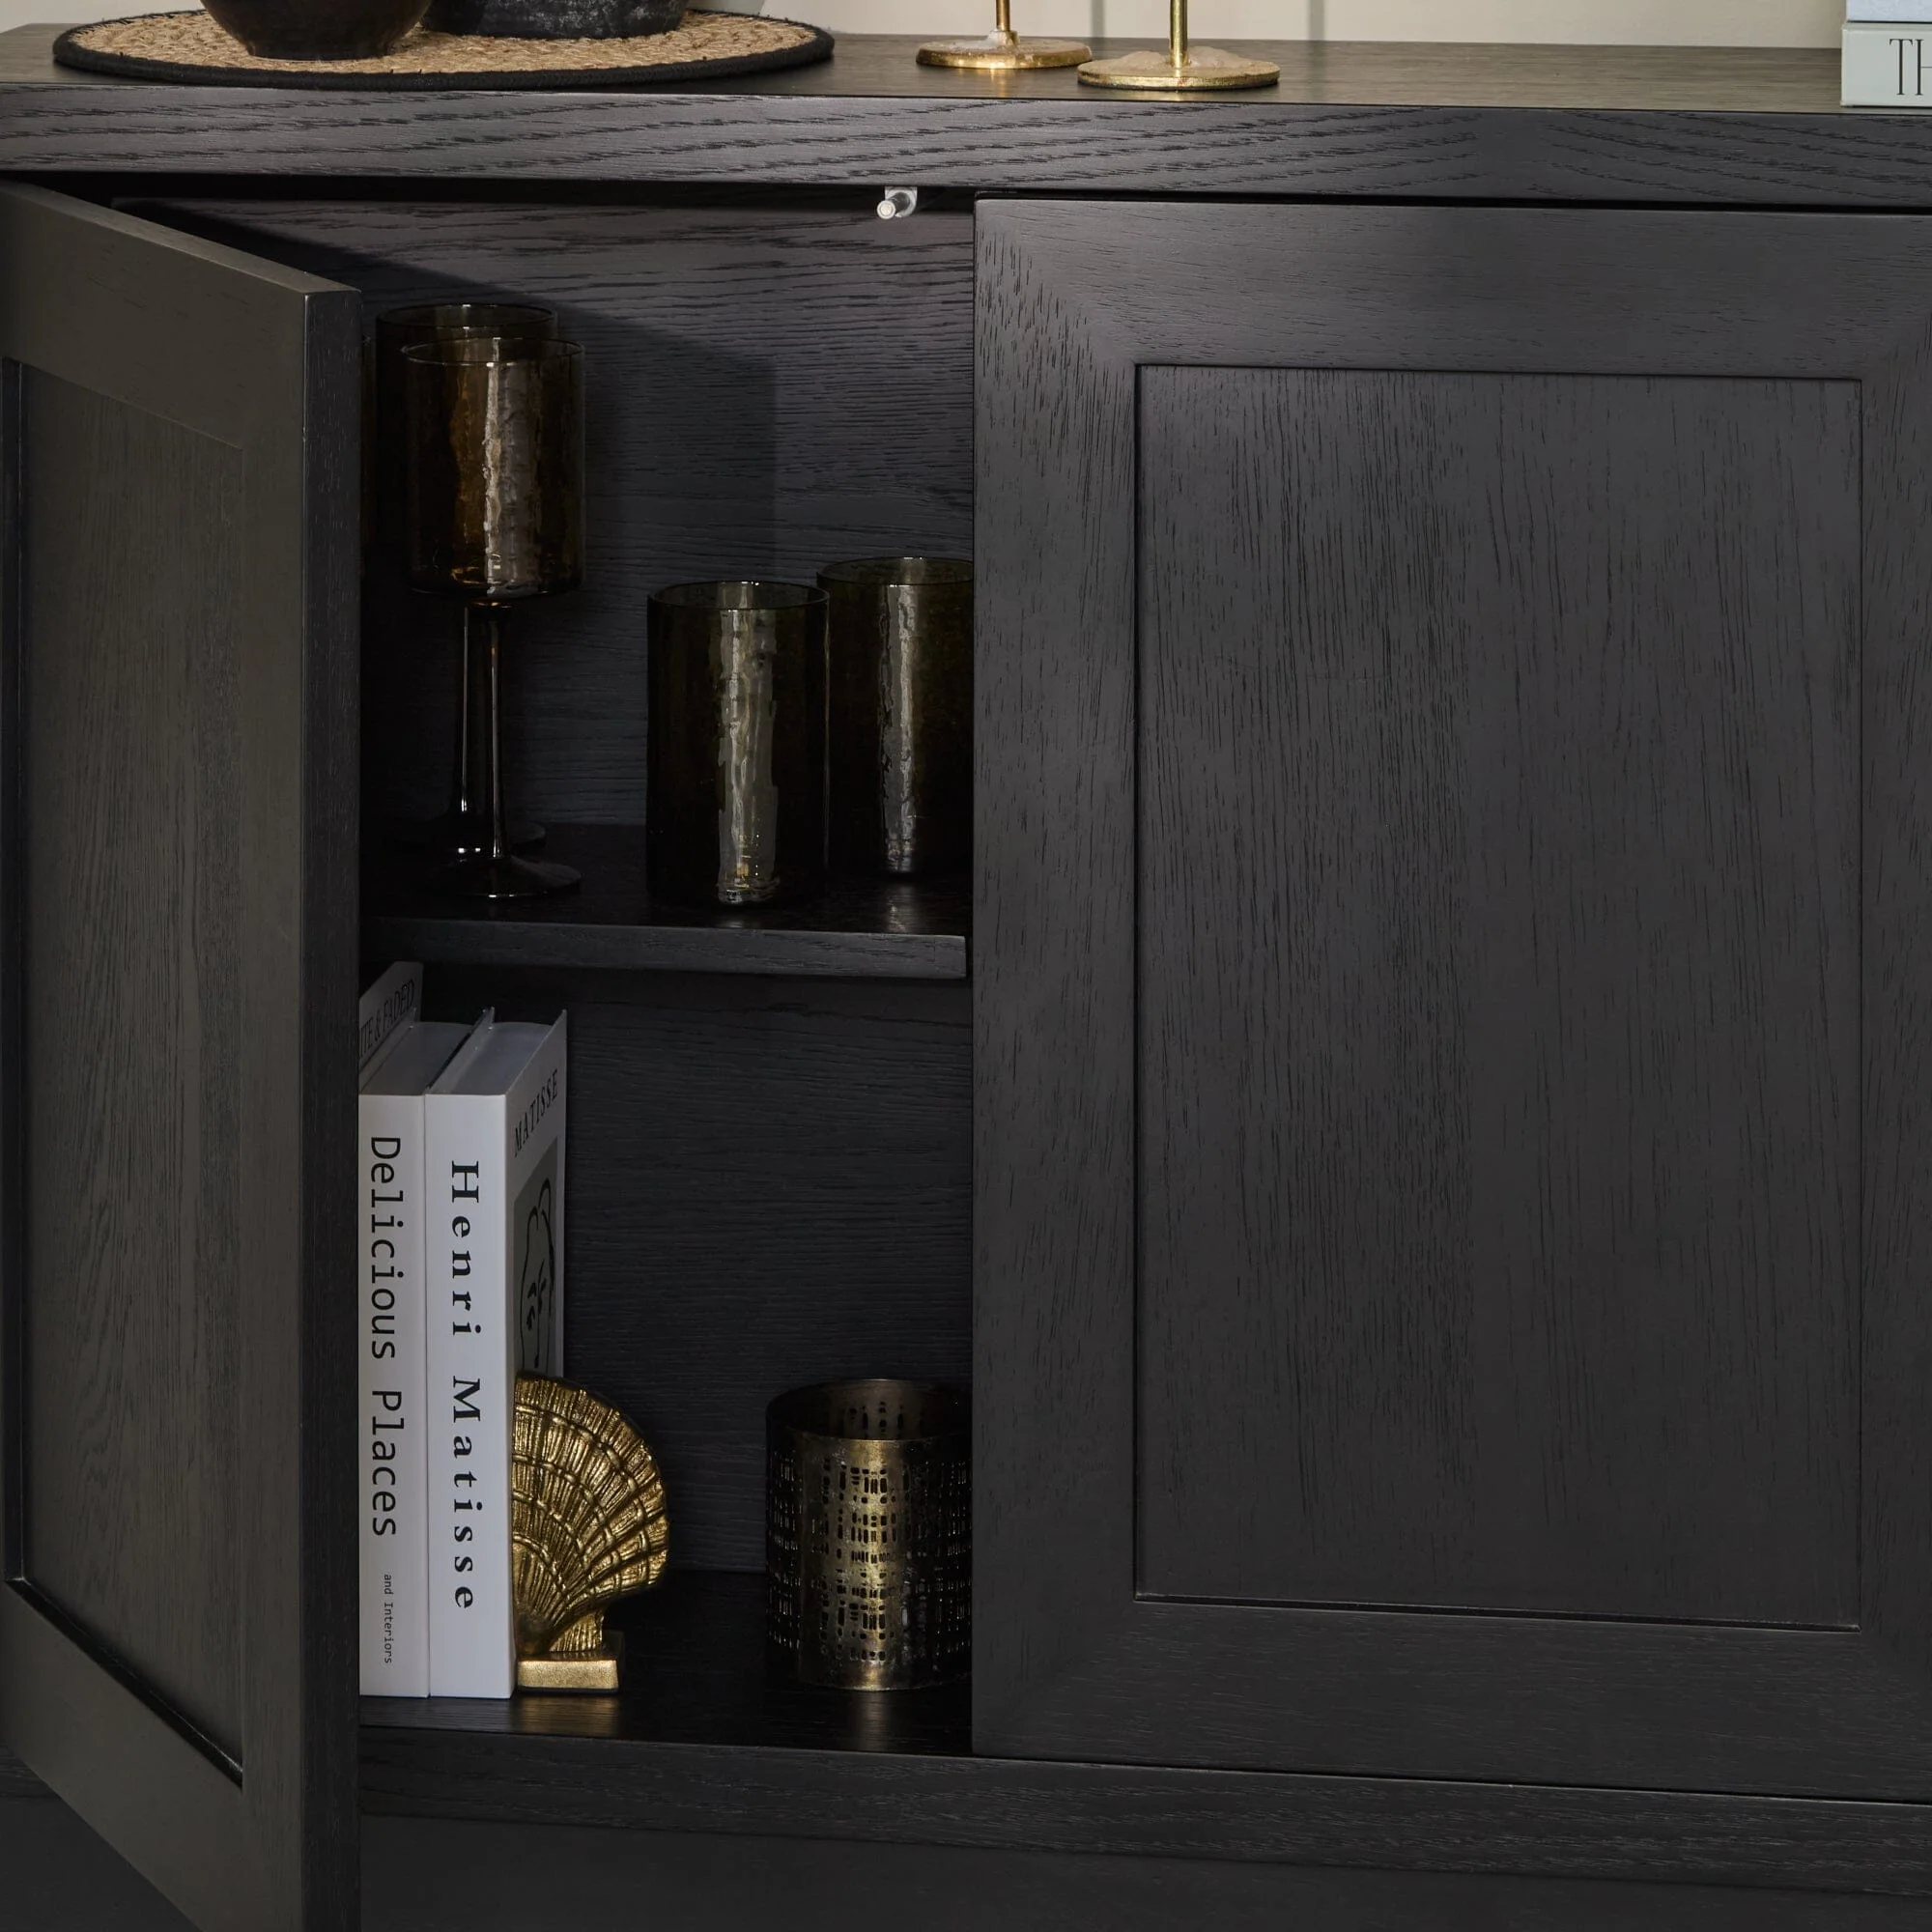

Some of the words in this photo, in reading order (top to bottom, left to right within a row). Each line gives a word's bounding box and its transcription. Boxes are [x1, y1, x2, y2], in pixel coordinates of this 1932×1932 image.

[384, 979, 415, 1033] FADED
[514, 1068, 558, 1157] MATISSE
[371, 1137, 404, 1359] Delicious
[452, 1161, 481, 1335] Henri
[372, 1391, 404, 1536] Places
[453, 1376, 482, 1608] Matisse
[384, 1574, 394, 1596] and
[384, 1602, 394, 1663] Interiors
